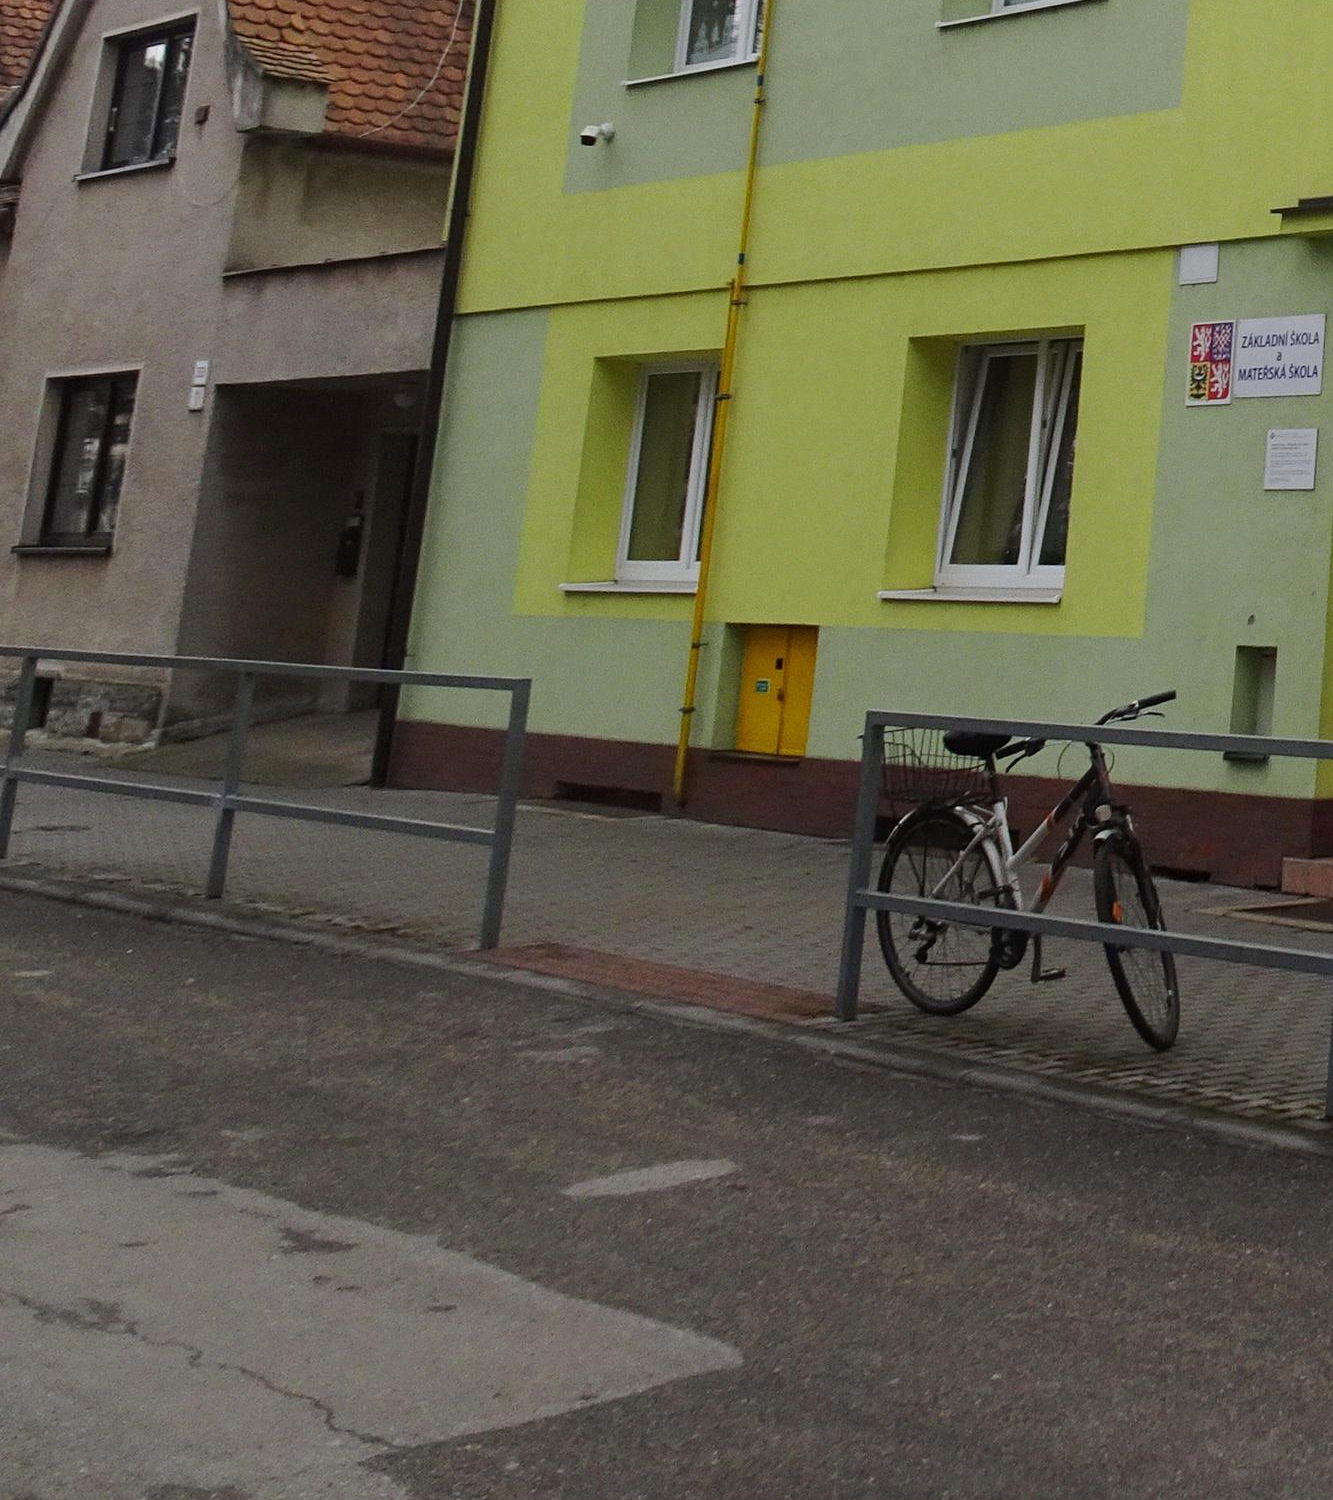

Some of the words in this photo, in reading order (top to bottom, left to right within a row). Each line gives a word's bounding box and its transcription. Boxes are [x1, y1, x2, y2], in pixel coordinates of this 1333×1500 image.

[1241, 330, 1288, 349] ZÁKLADNÍ
[1289, 330, 1320, 347] ŠKOLA
[1276, 351, 1282, 361] a
[1237, 364, 1287, 381] MATEŘSKÁ
[1288, 363, 1319, 379] ŠKOLA
